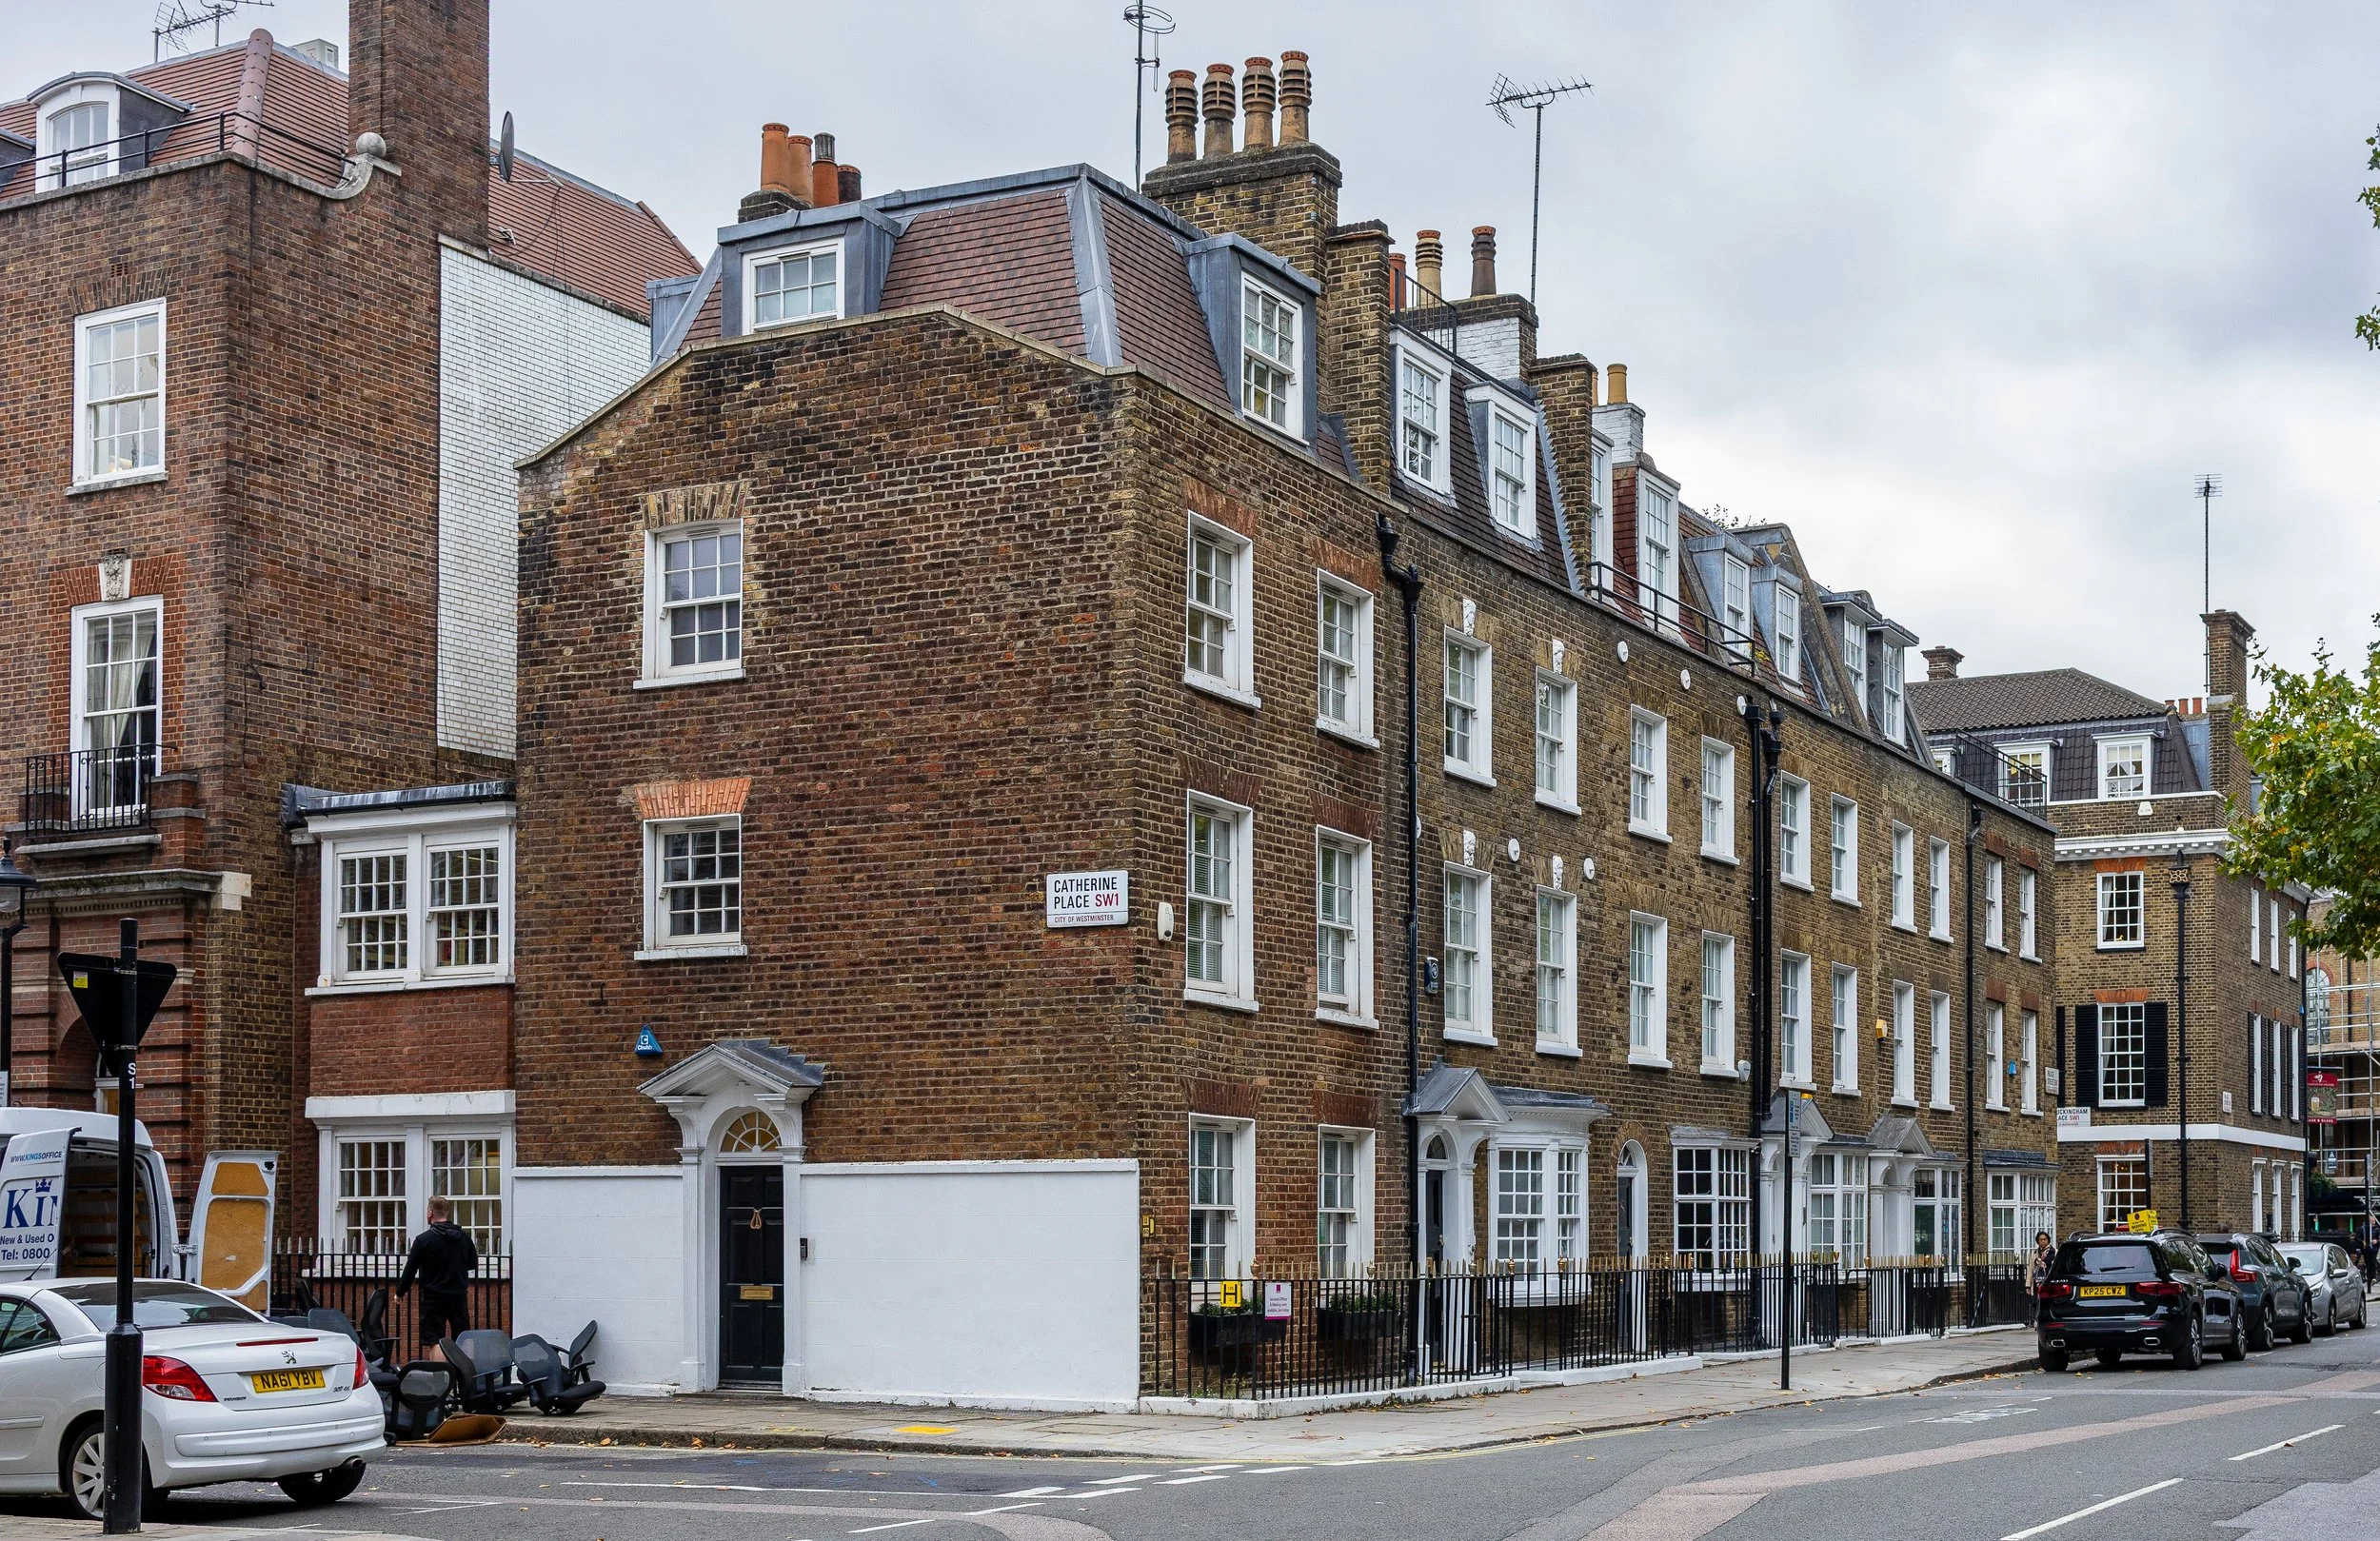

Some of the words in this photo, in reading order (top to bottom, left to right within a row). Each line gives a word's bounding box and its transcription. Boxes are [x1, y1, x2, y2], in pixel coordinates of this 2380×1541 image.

[1054, 877, 1118, 893] CATHERINE
[1054, 895, 1090, 909] PLACE
[1095, 893, 1119, 907] SW1
[25, 1234, 46, 1244] Used
[2, 1249, 18, 1260] Tel:
[22, 1248, 50, 1259] 0800
[2083, 1286, 2105, 1295] KP25
[260, 1372, 292, 1390] NA61
[292, 1371, 317, 1386] YBV
